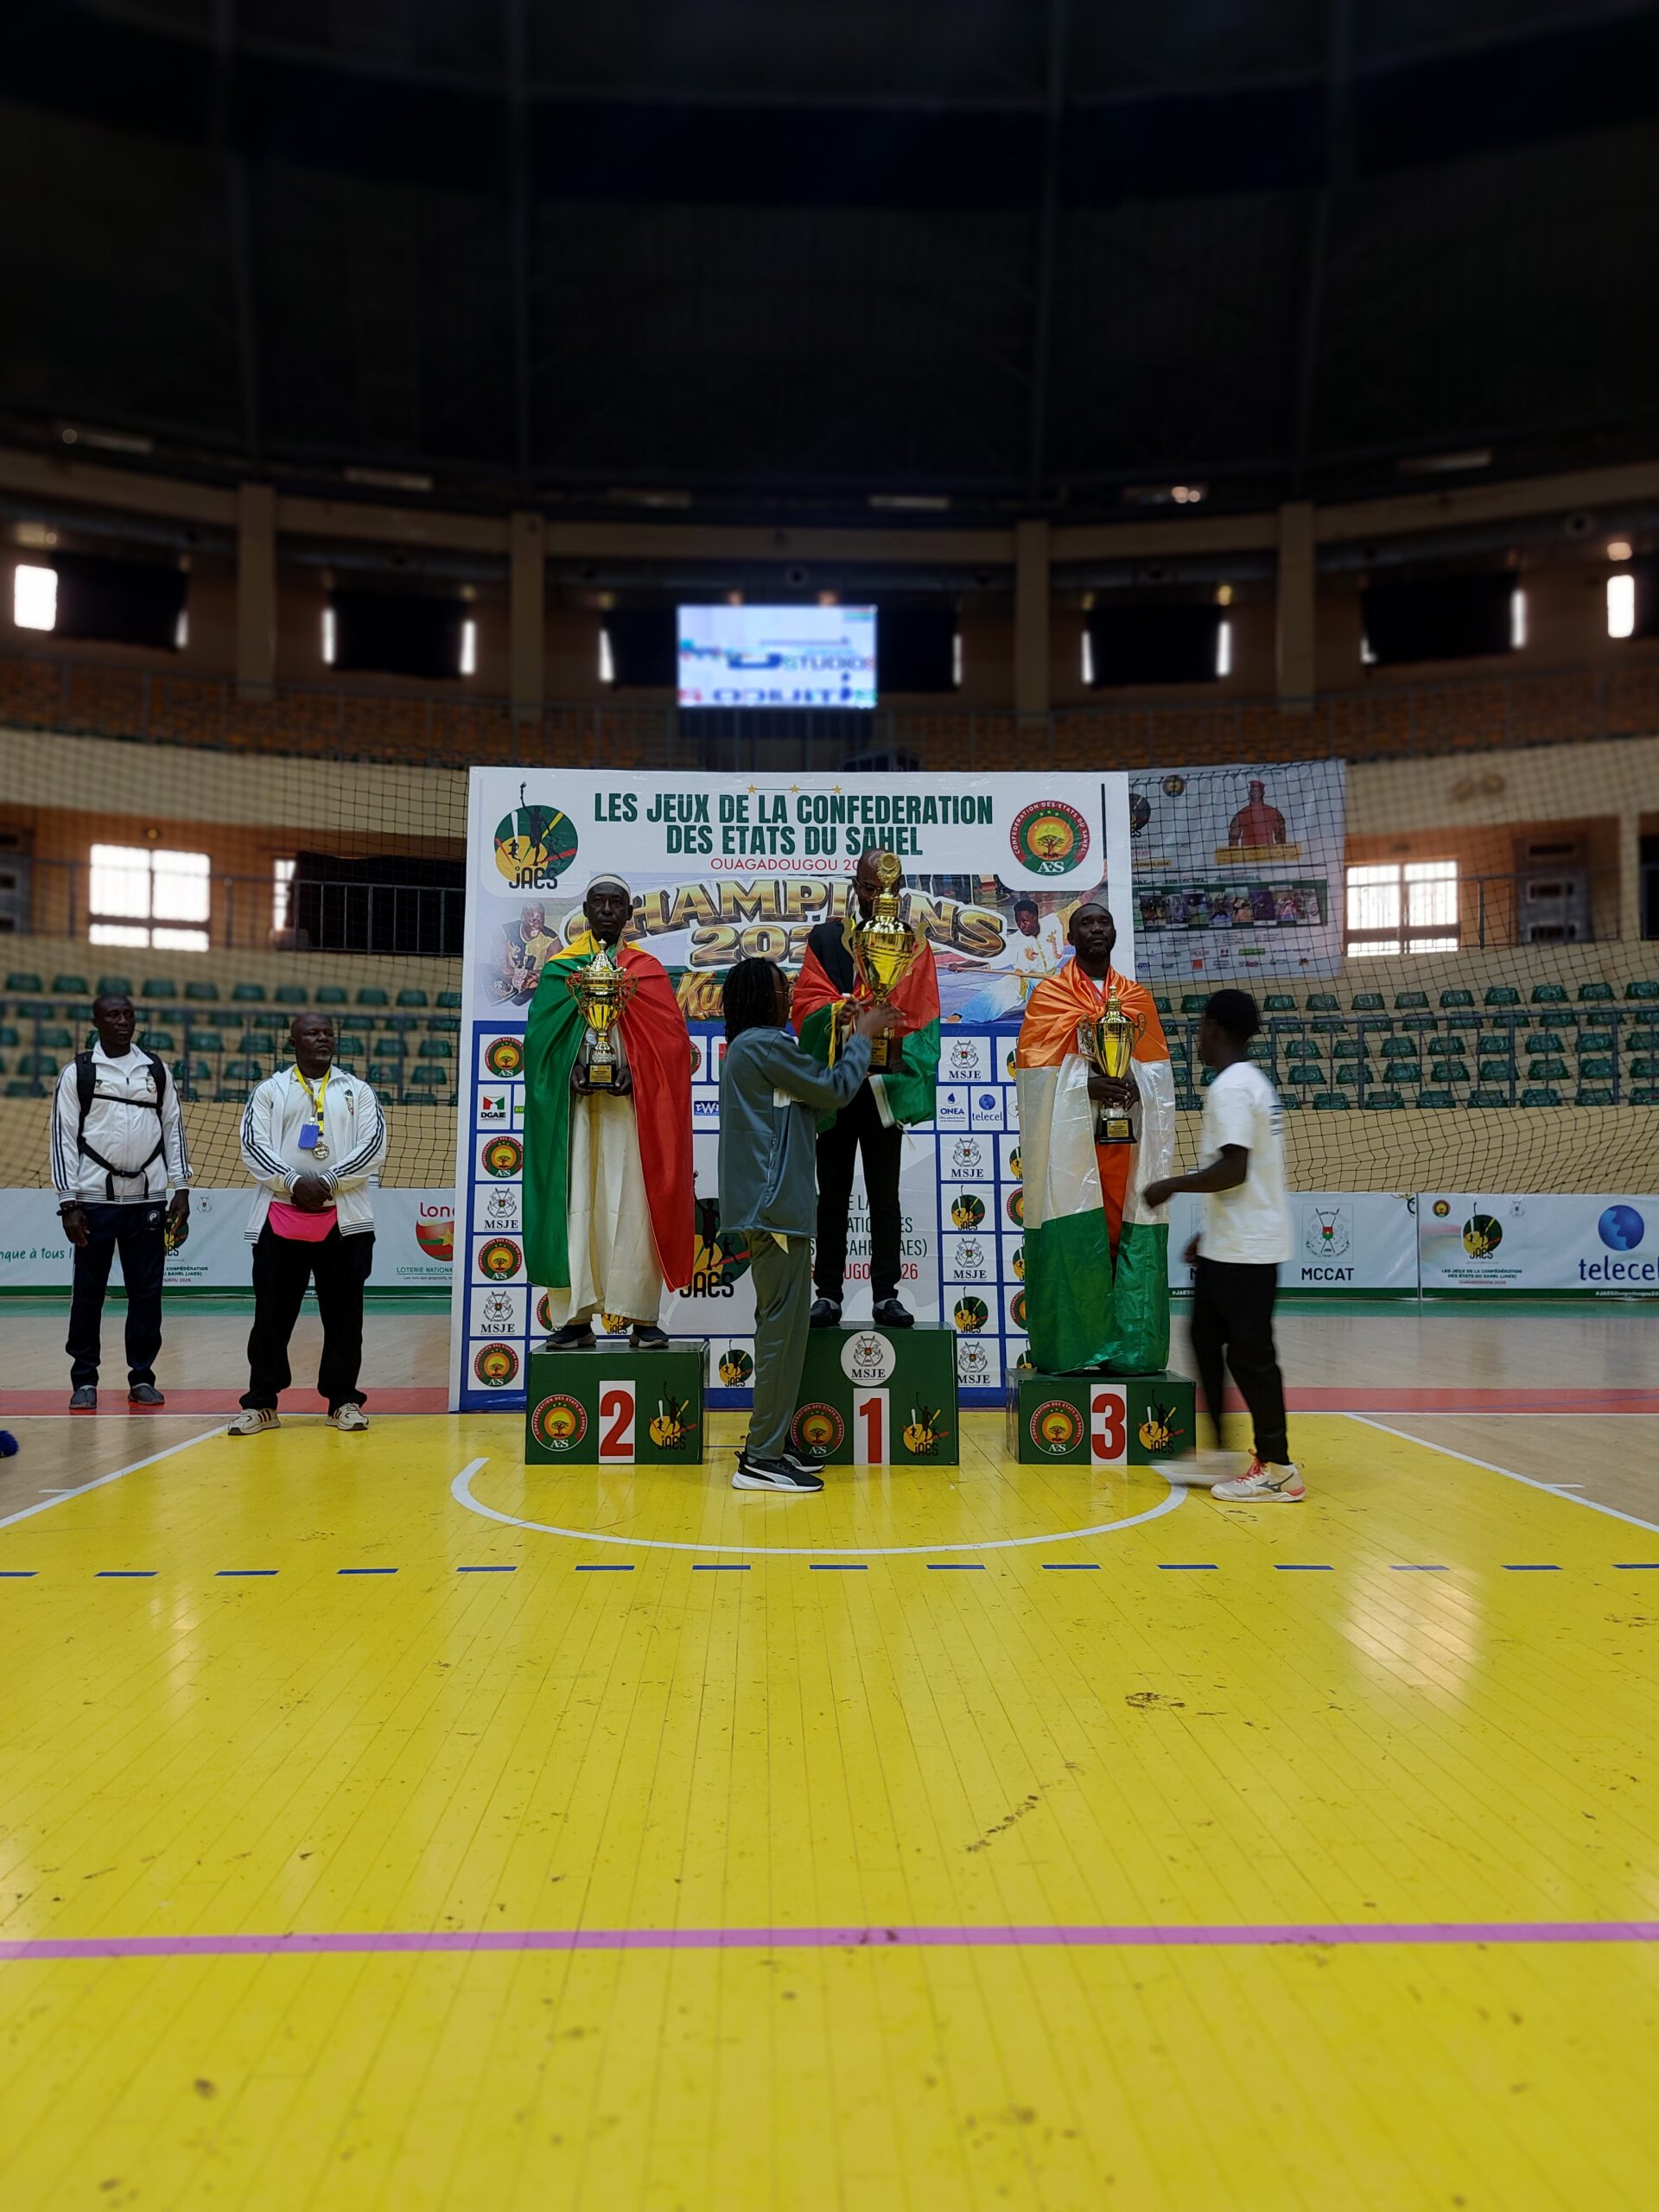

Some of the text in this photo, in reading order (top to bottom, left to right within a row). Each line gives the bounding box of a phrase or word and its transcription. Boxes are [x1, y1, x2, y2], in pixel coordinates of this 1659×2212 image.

[594, 793, 994, 824] LES JEUX DE LA CONFEDERATION
[1011, 803, 1039, 855] CONFEDERATION
[666, 825, 924, 855] DES ETATS DU SAHEL
[710, 858, 838, 871] OUAGADOUGOU
[1037, 861, 1065, 873] AES
[564, 879, 1006, 958] HAMPINS
[690, 924, 813, 968] 20
[972, 1111, 1002, 1121] telecel
[950, 1169, 984, 1178] MSJE
[484, 1220, 518, 1229] MSJE
[29, 1247, 37, 1259] à
[41, 1247, 66, 1259] tous
[954, 1270, 987, 1279] MSJE
[1301, 1268, 1355, 1281] MCCAT
[480, 1324, 515, 1332] MSJE
[851, 1369, 886, 1378] MSJE
[957, 1375, 991, 1383] MSJE
[599, 1389, 634, 1457] 2
[1091, 1393, 1126, 1460] 3
[860, 1398, 882, 1464] 1
